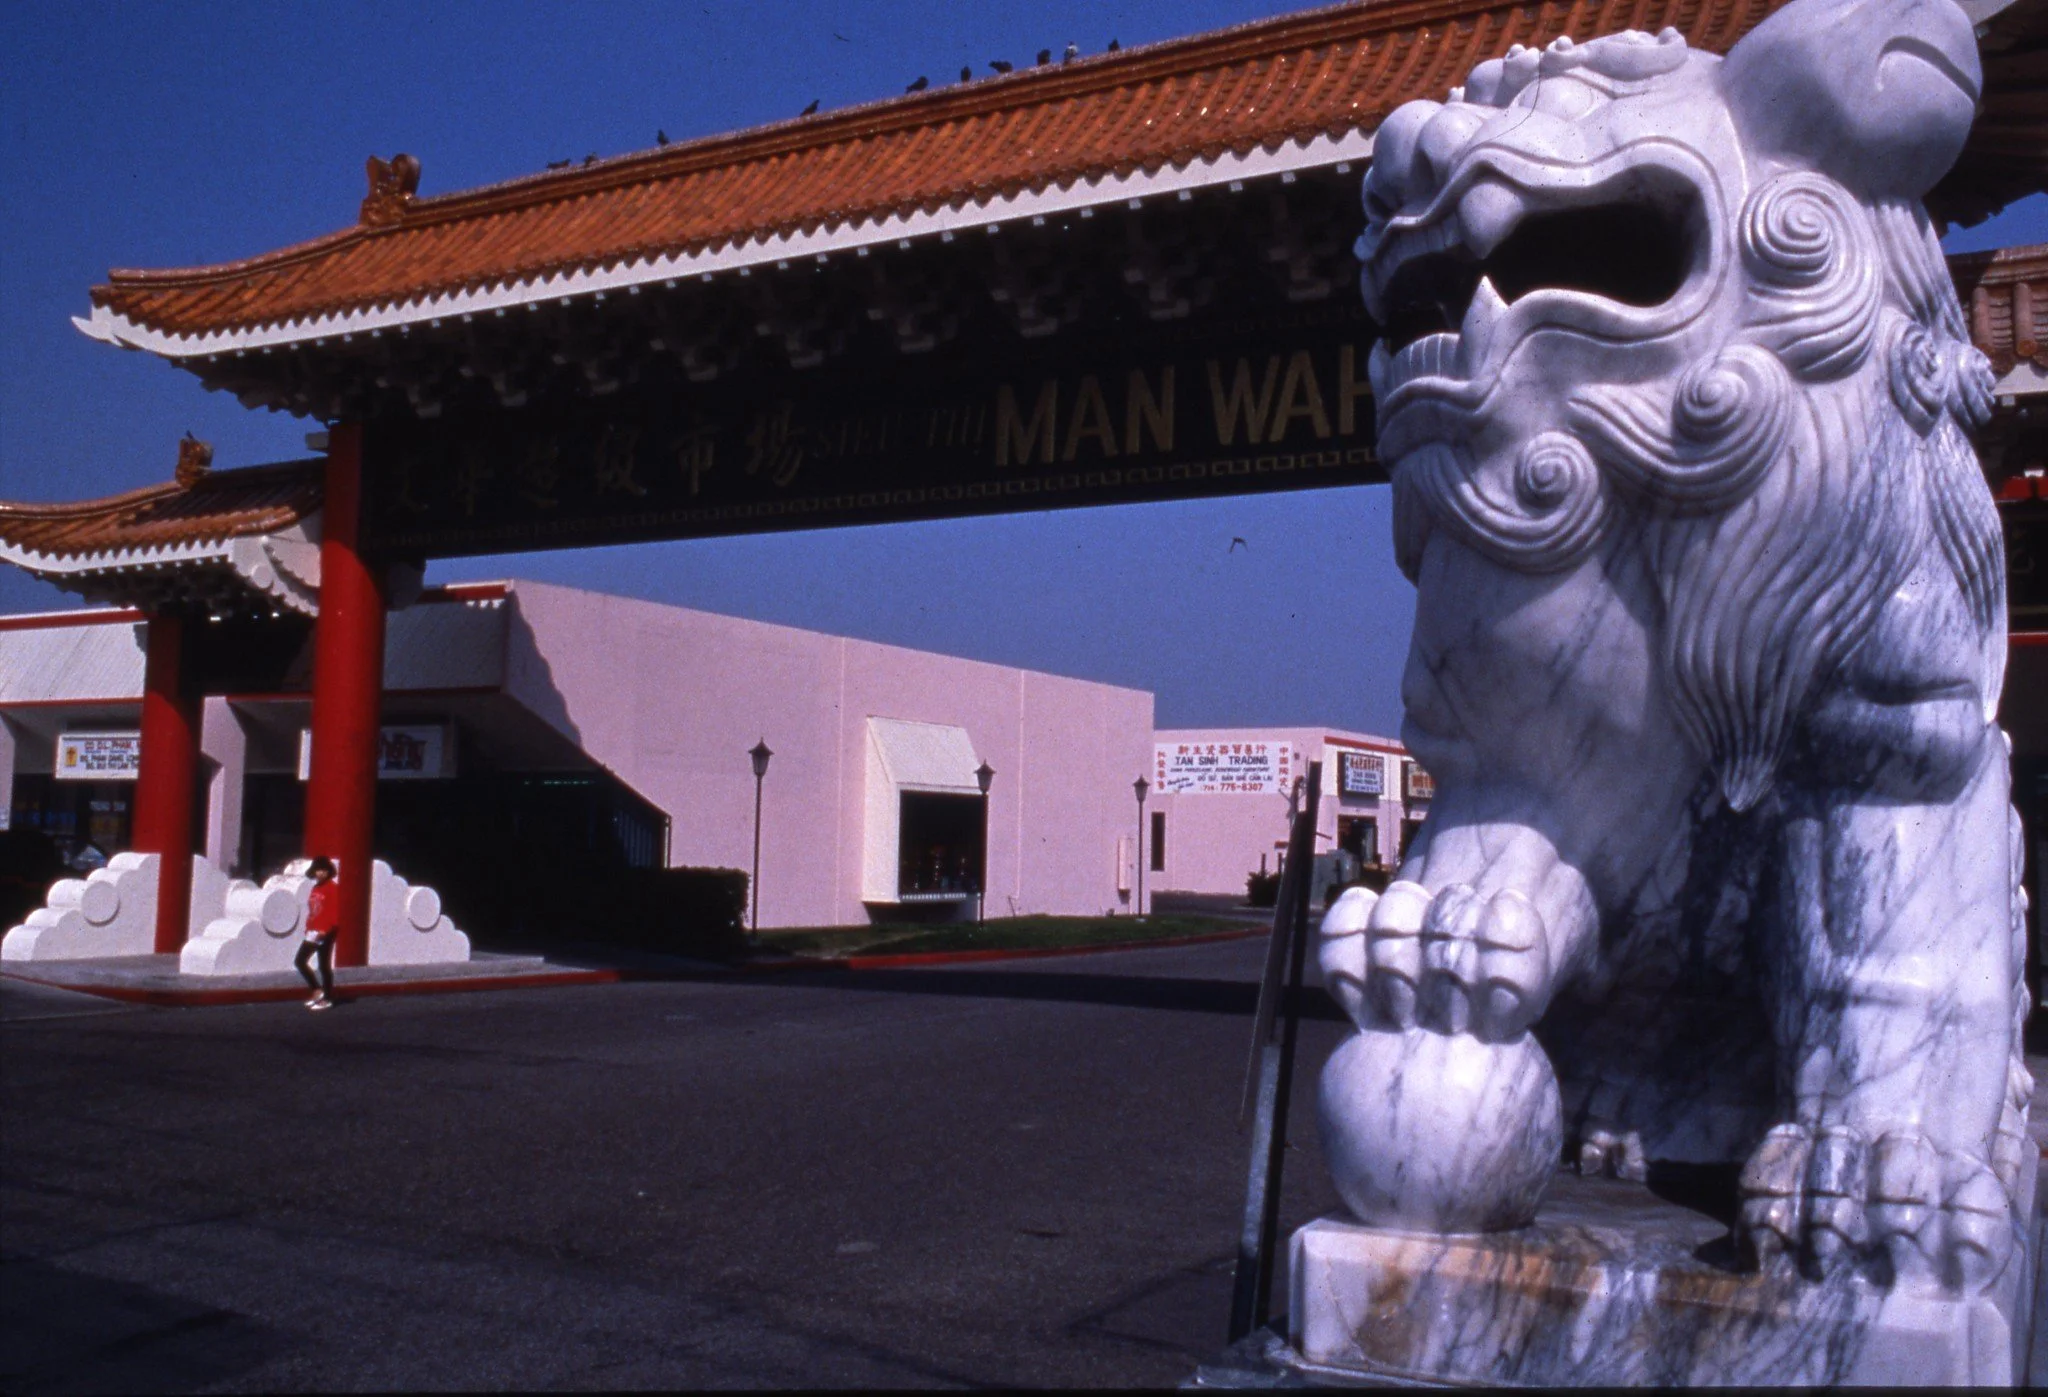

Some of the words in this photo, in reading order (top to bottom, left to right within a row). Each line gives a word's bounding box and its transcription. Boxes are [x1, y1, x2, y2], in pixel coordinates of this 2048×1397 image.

[994, 364, 1177, 467] MAN
[1206, 337, 1391, 446] WAH
[1175, 756, 1194, 765] TAN
[1198, 756, 1219, 765] SINH
[1228, 755, 1269, 765] TRADING
